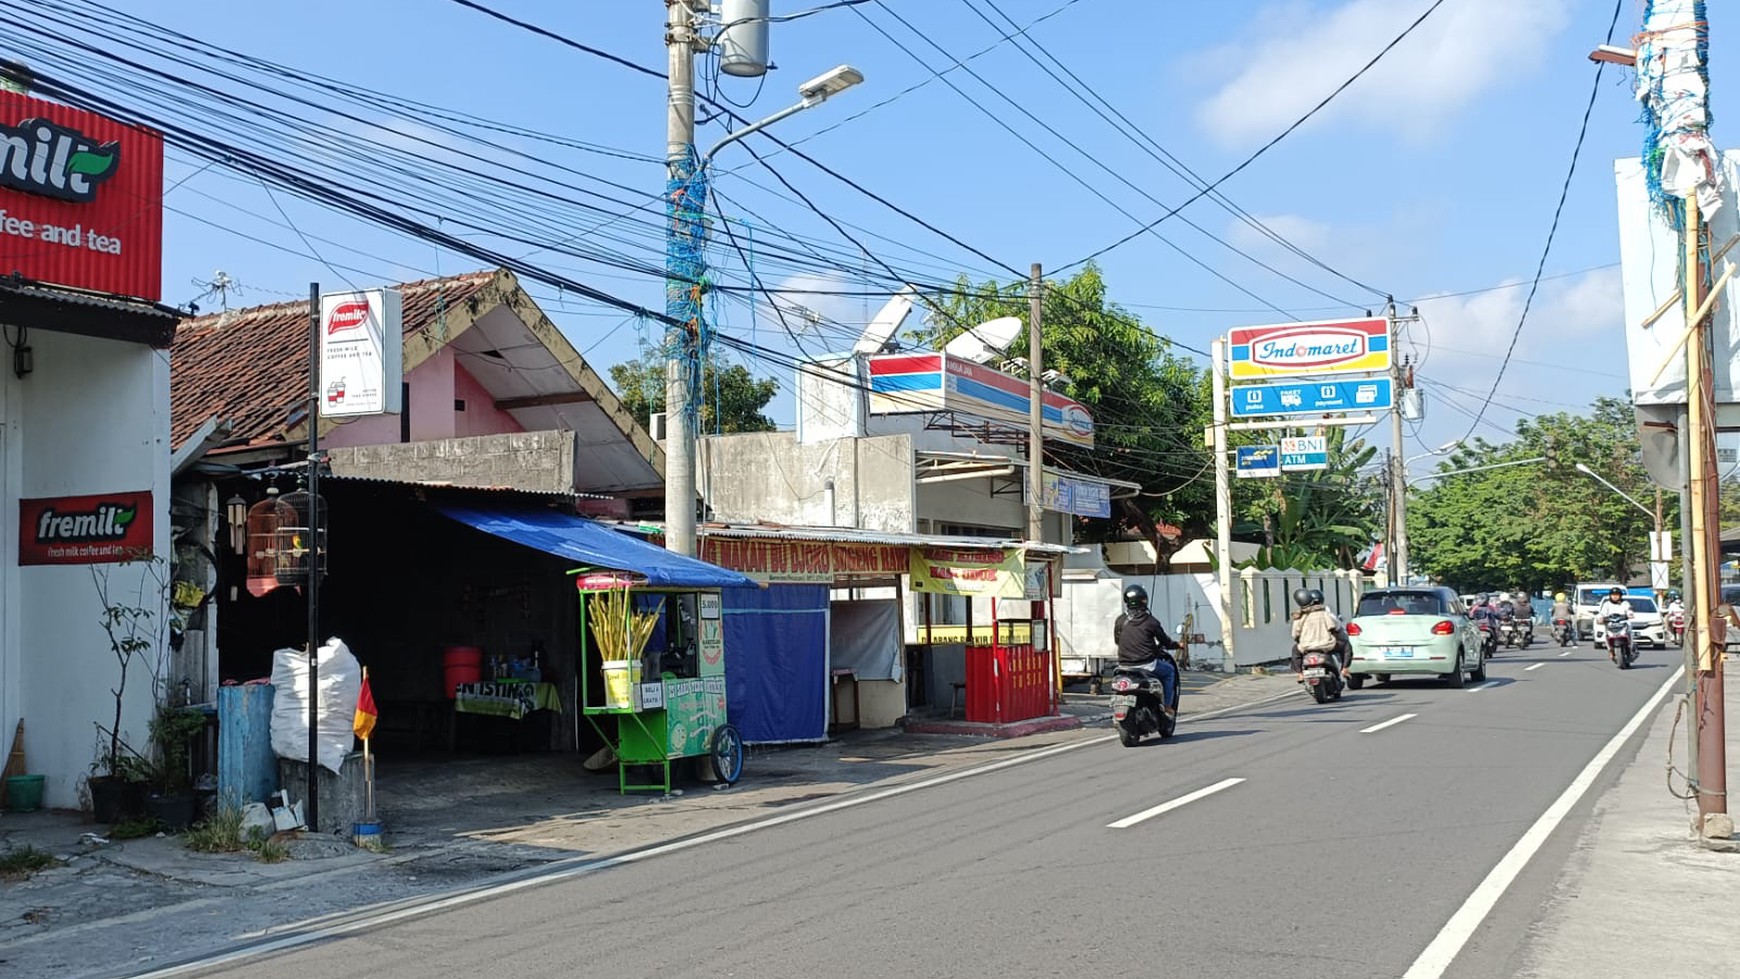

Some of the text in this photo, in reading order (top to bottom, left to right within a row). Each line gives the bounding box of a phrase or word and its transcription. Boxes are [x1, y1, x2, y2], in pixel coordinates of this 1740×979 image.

[41, 223, 81, 247] and
[87, 228, 122, 255] tea
[1259, 338, 1357, 358] Indomaret
[1298, 439, 1323, 451] BNI
[1284, 454, 1306, 464] ATM
[48, 547, 65, 557] fresh
[66, 547, 79, 557] milk
[80, 546, 99, 556] coffee
[100, 546, 112, 555] and
